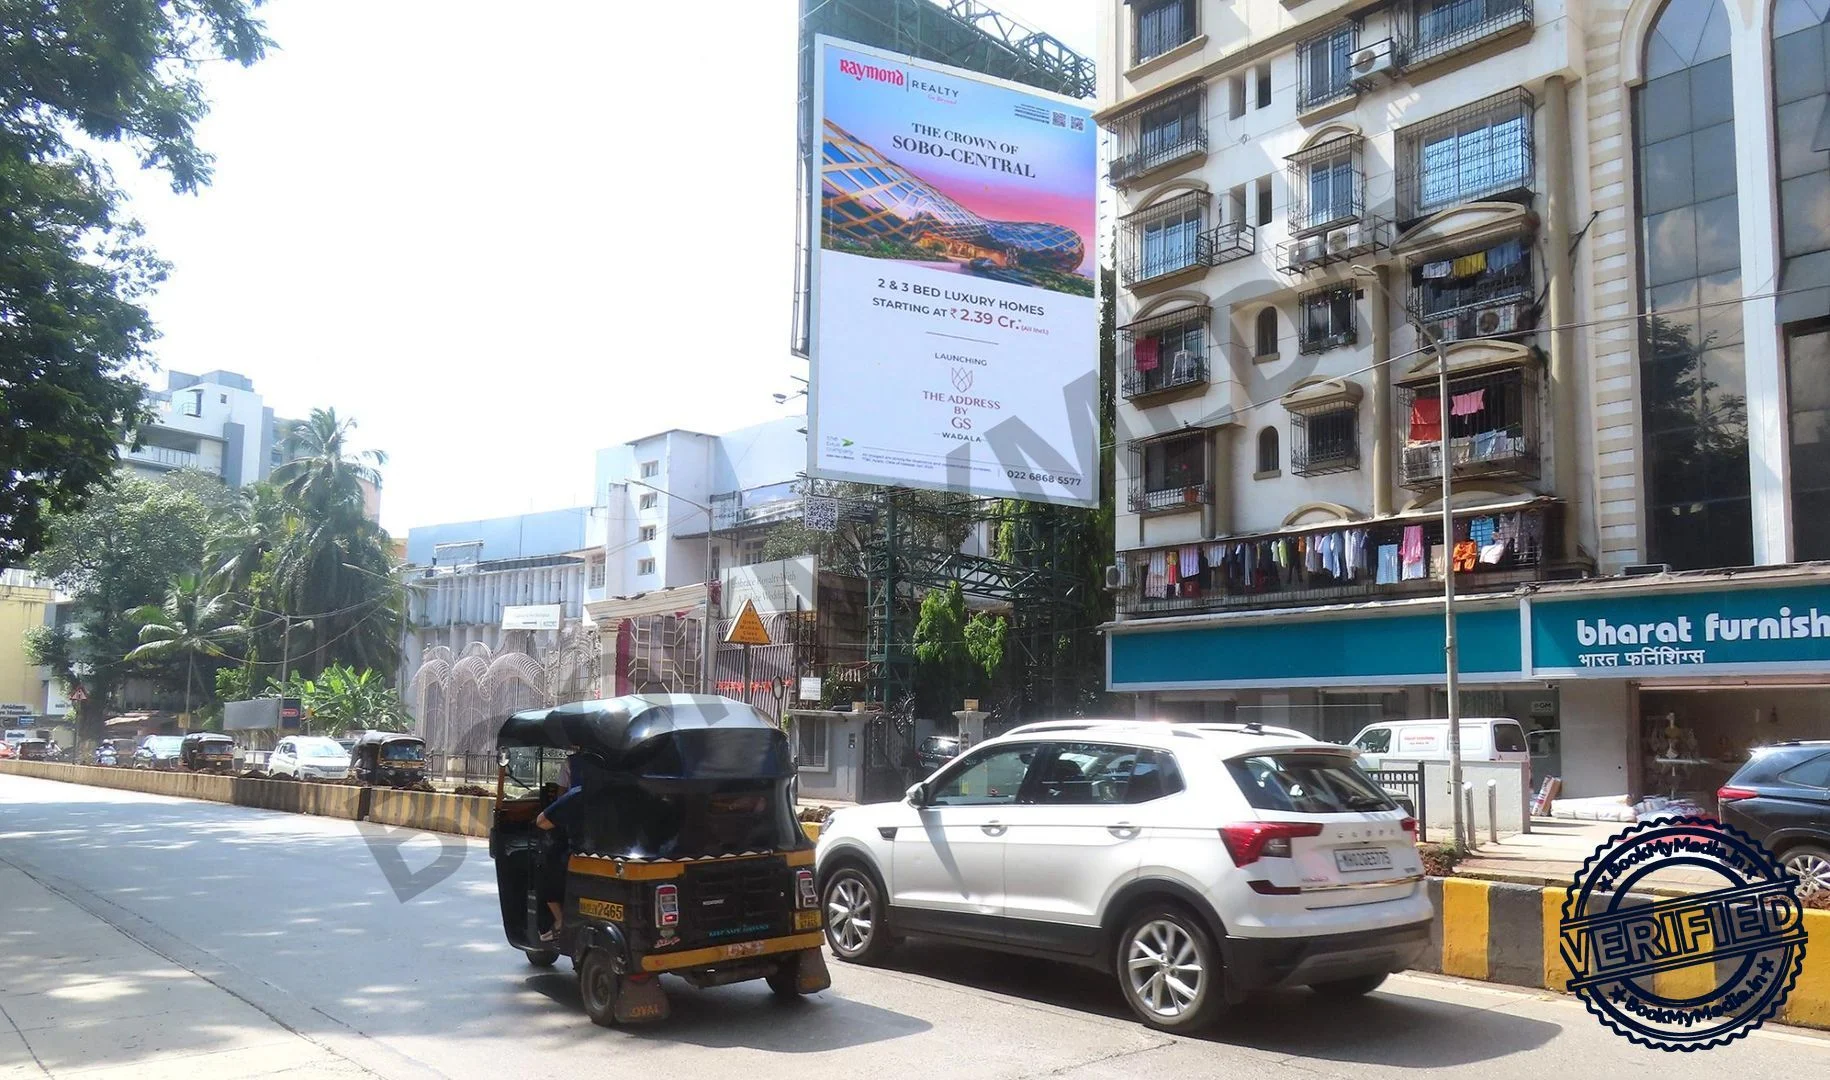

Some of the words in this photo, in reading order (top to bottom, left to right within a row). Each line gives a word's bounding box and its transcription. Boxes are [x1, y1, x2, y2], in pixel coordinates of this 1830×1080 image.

[840, 58, 904, 87] Raymond
[912, 80, 959, 98] REALTY
[912, 123, 941, 138] THE
[944, 131, 996, 149] CROWN
[1000, 142, 1019, 154] OF
[892, 135, 1035, 178] SOBO-CENTRAL
[878, 279, 885, 288] 2
[889, 281, 898, 290] &
[901, 281, 909, 292] 3
[913, 284, 941, 297] BED
[944, 289, 996, 307] LUXURY
[999, 300, 1045, 316] HOMES
[872, 297, 930, 315] STARTING
[932, 308, 948, 318] AT
[950, 308, 957, 319] ₹
[960, 308, 993, 325] 2.39
[934, 353, 987, 366] LAUNCHING
[922, 390, 946, 402] THE
[948, 394, 1000, 410] ADDRESS
[954, 406, 969, 415] BY
[951, 416, 972, 430] GS
[942, 431, 982, 443] WADALA
[1007, 469, 1026, 480] 022
[1029, 471, 1055, 483] 6868
[1058, 475, 1081, 487] 5577
[1576, 617, 1692, 647] bharat
[1578, 652, 1619, 667] भारत
[1625, 647, 1705, 666] फर्निशिंग्स
